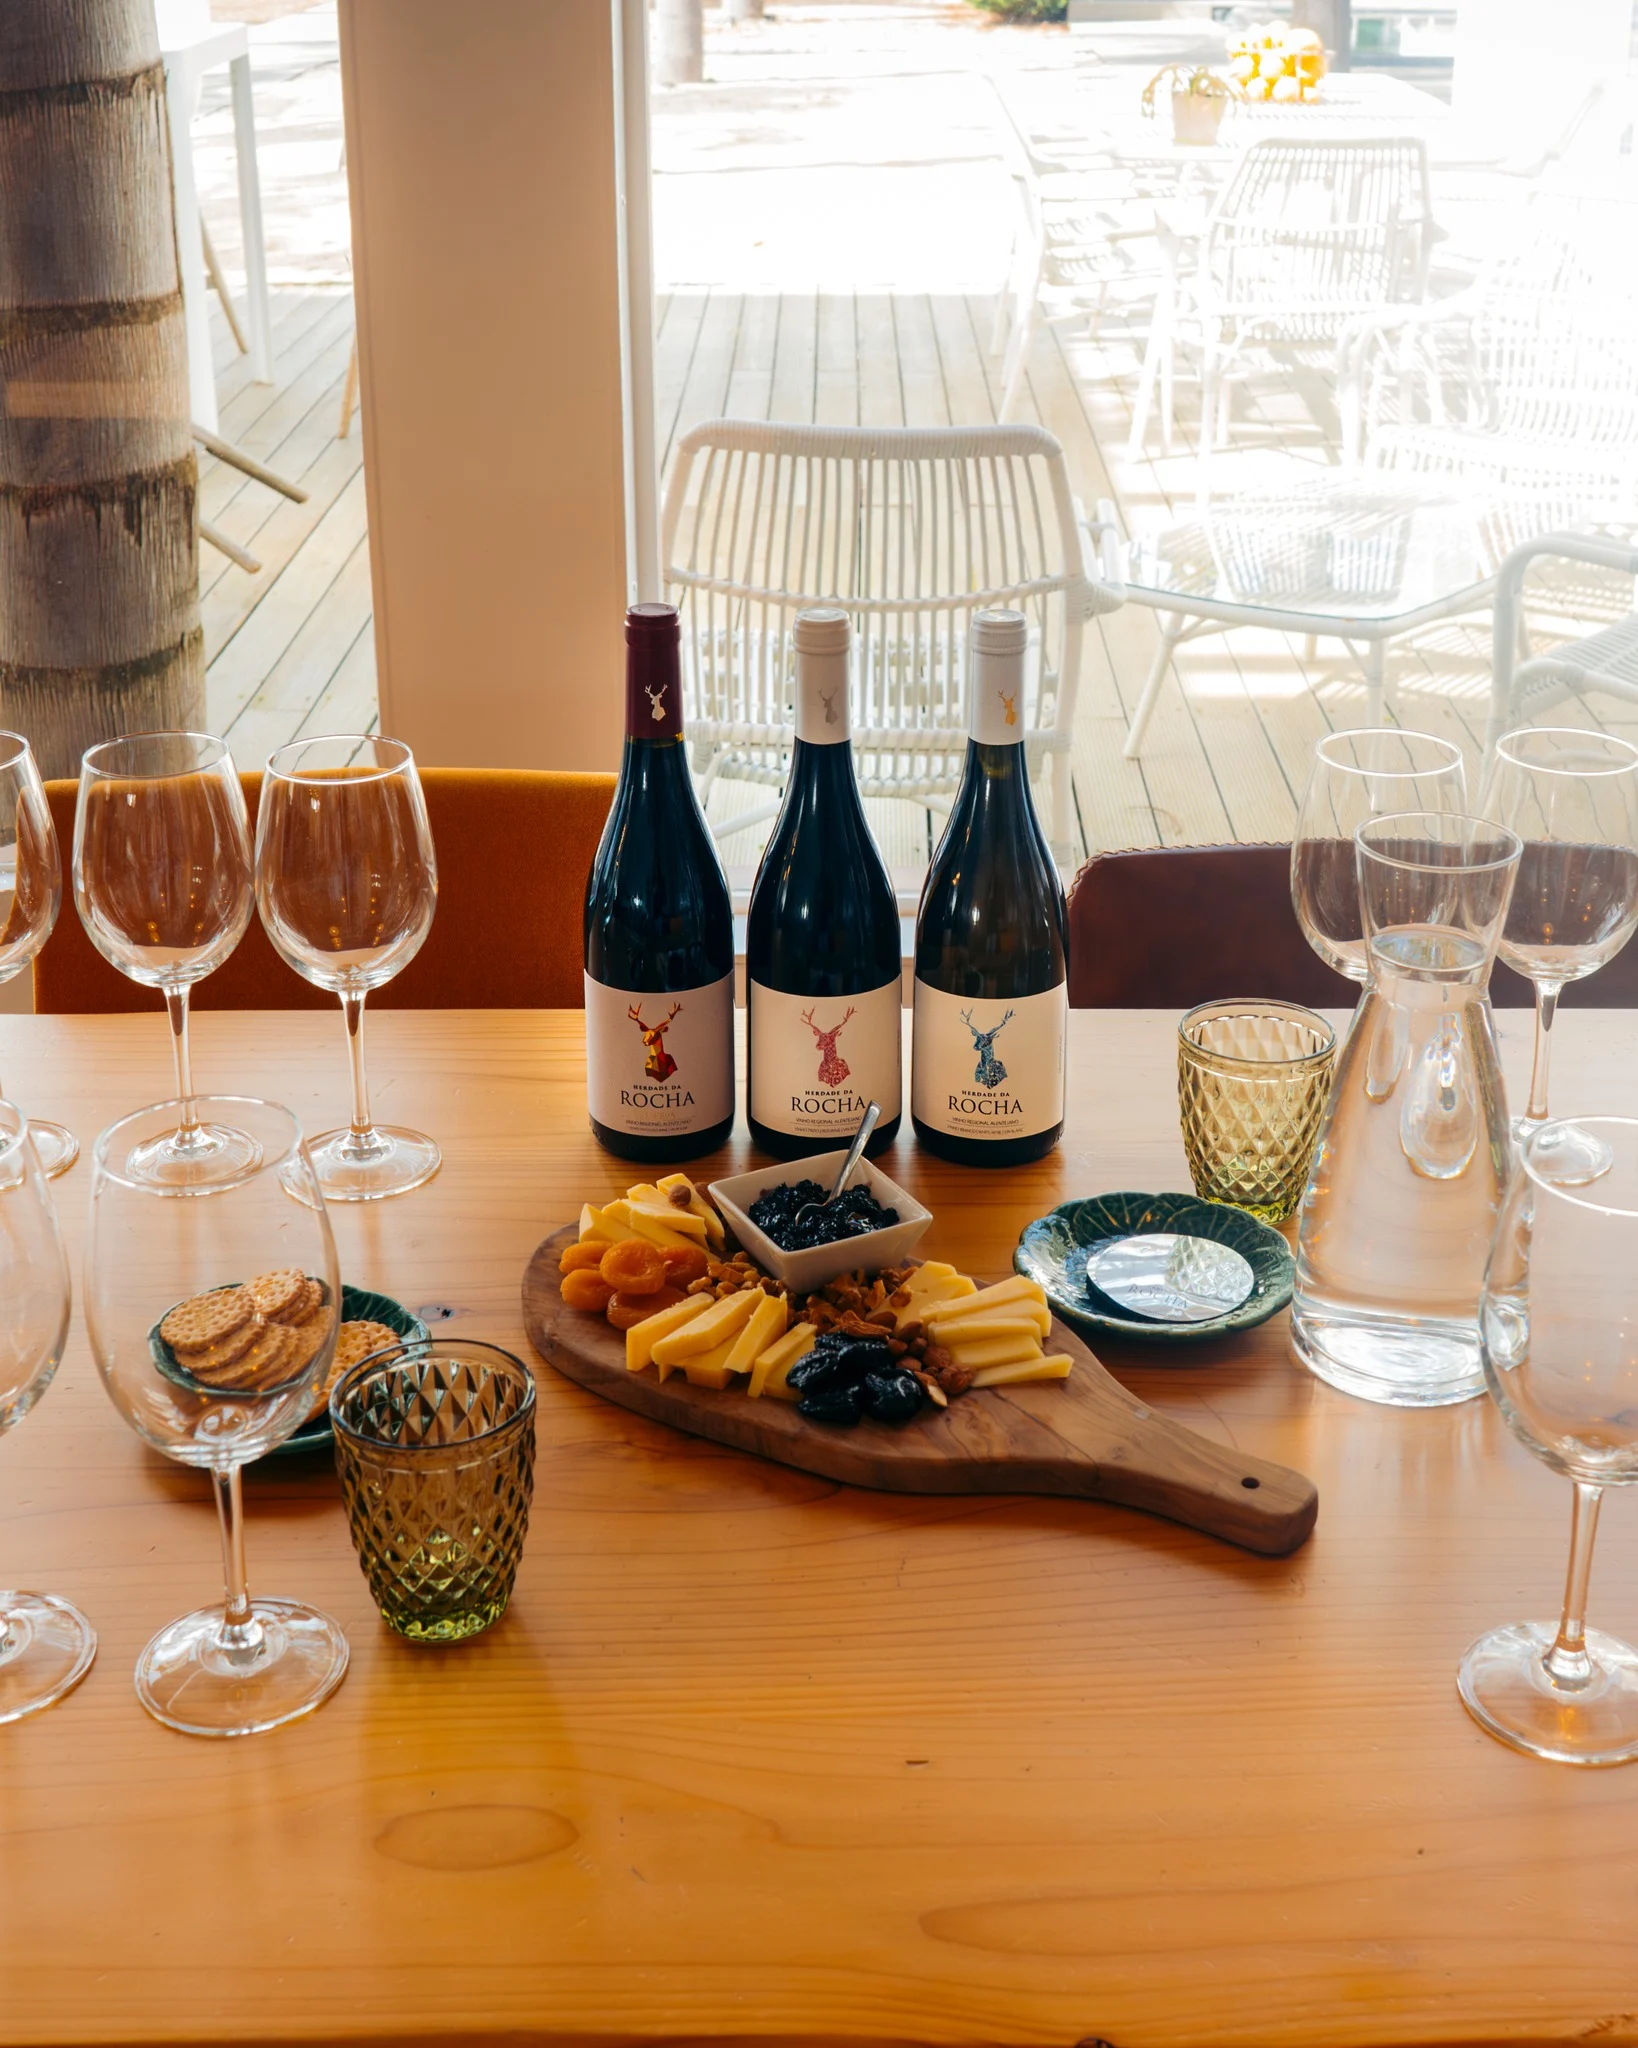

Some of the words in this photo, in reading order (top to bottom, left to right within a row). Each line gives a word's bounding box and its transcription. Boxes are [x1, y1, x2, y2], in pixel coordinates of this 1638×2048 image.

[621, 1090, 695, 1109] ROCHA
[961, 1090, 997, 1098] HERDADE
[791, 1096, 866, 1114] ROCHA
[948, 1095, 1024, 1116] ROCHA
[1129, 1284, 1187, 1308] ROCHA
